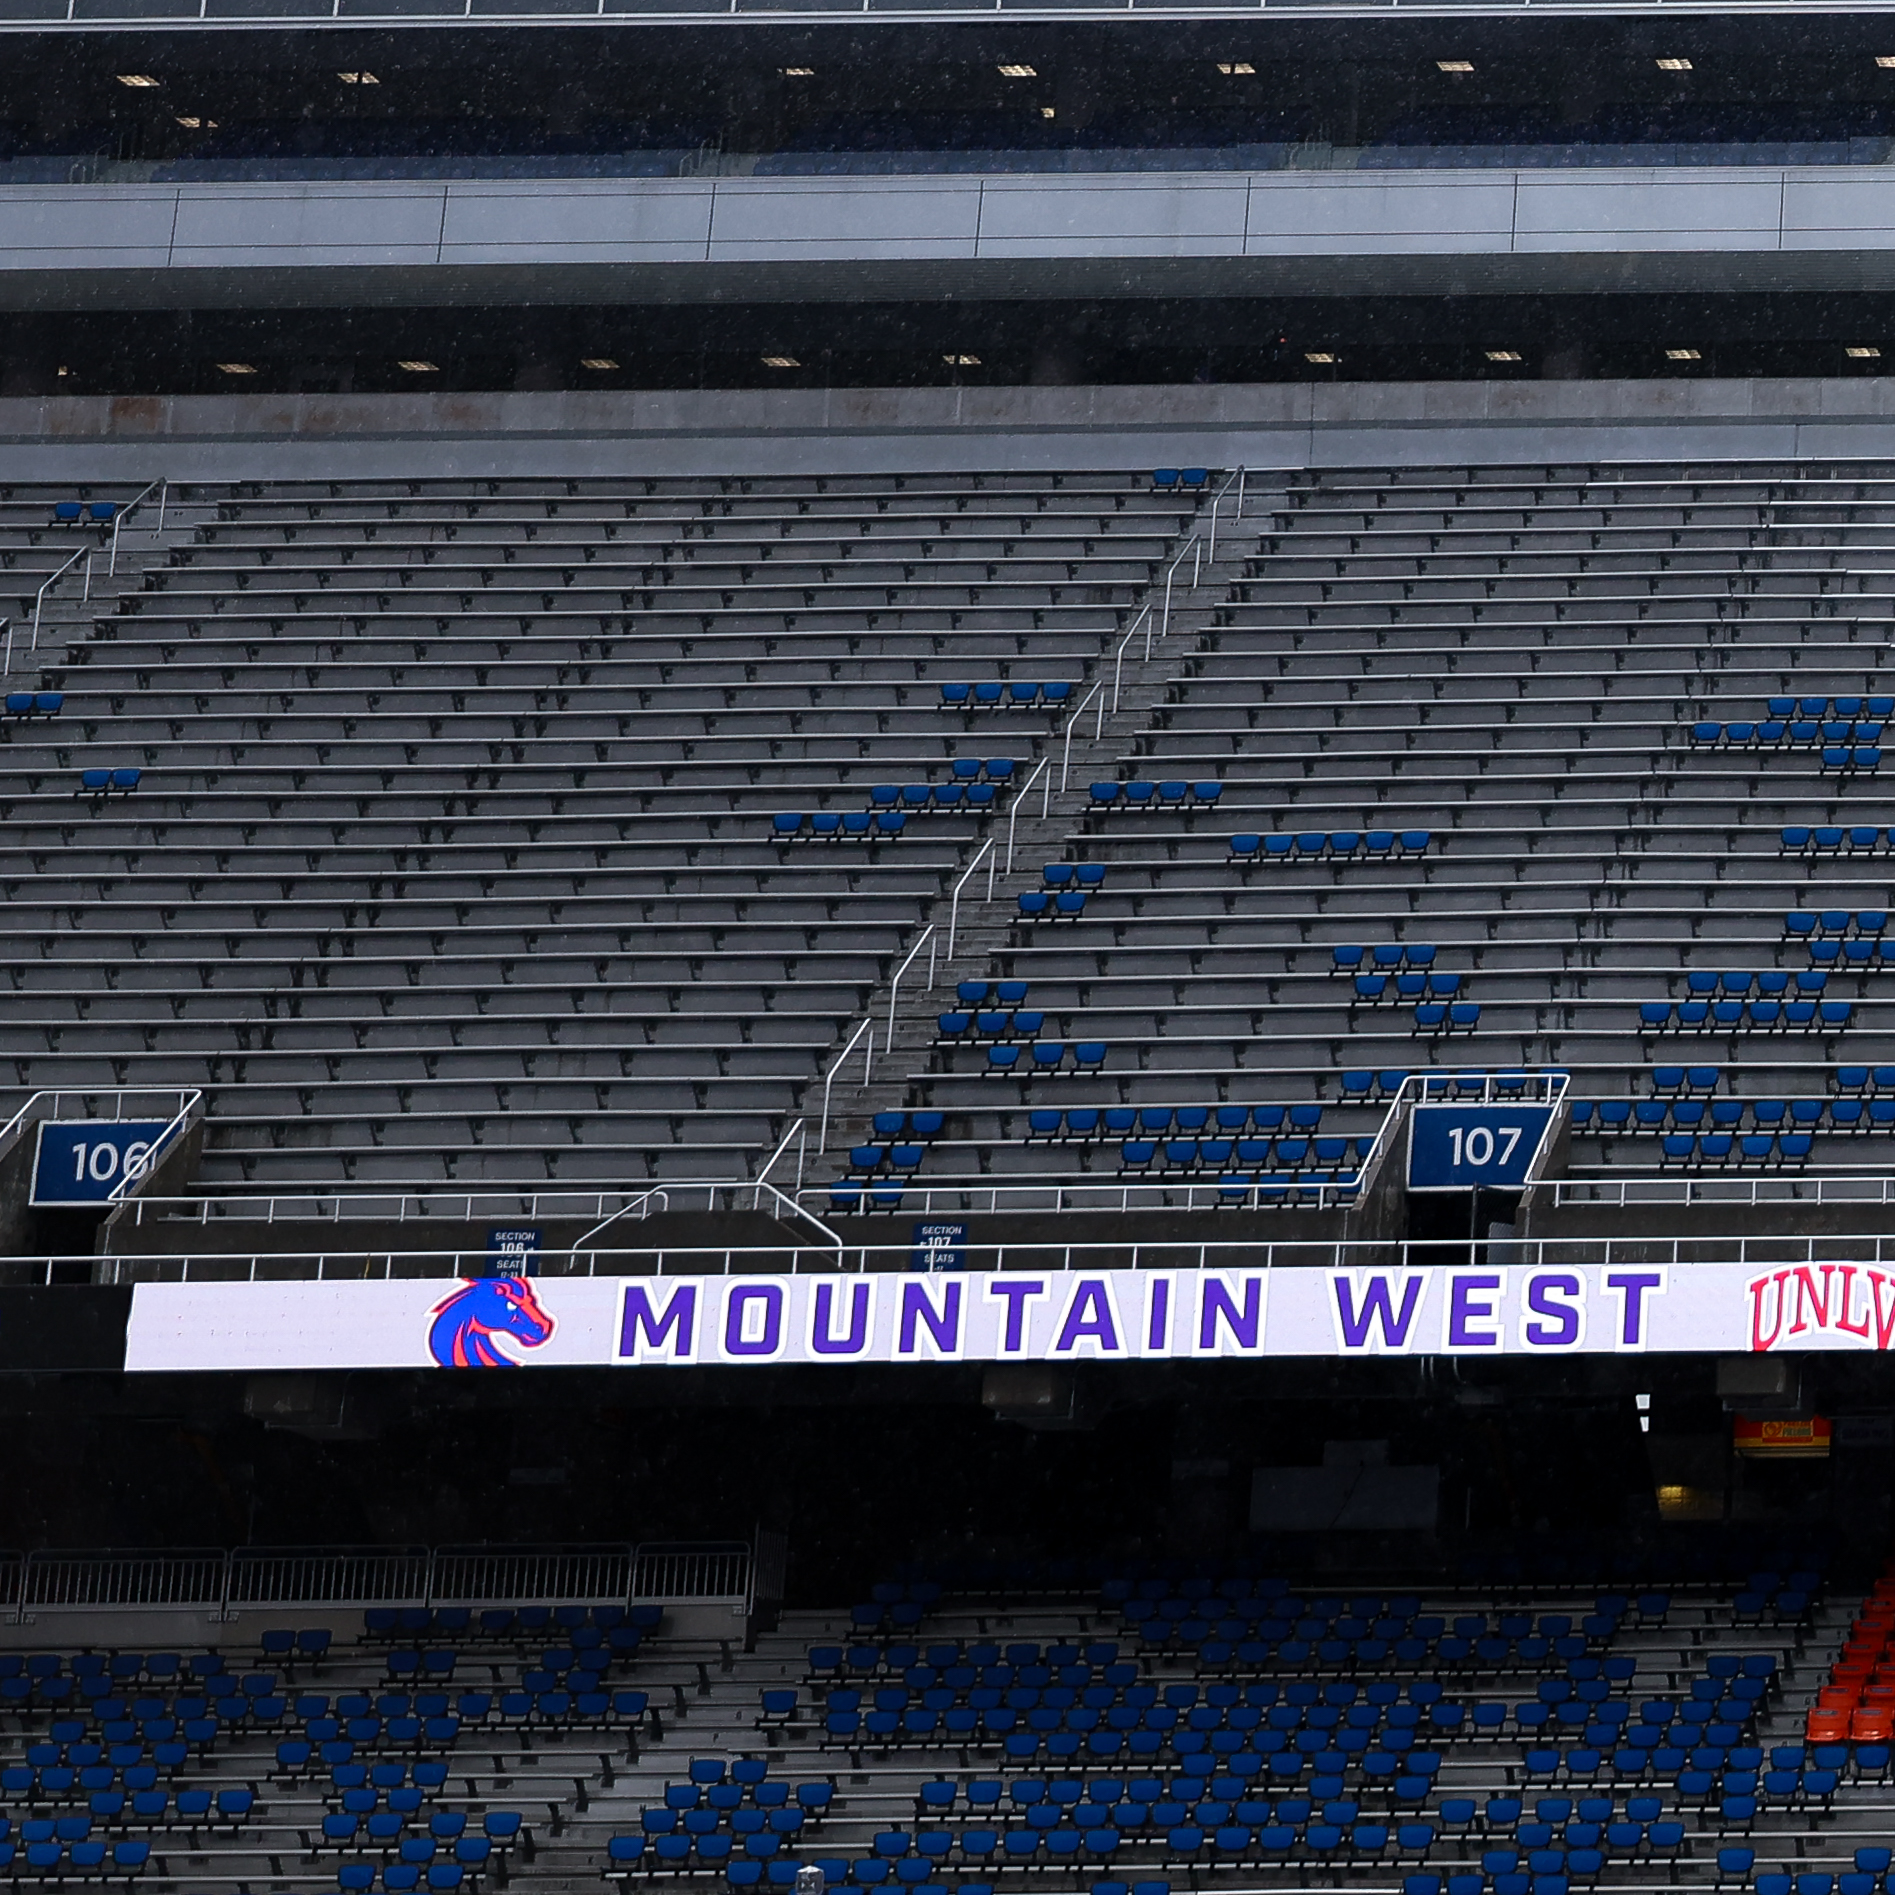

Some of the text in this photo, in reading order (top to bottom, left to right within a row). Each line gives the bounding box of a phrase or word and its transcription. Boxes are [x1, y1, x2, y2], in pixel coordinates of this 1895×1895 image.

[1448, 1127, 1522, 1166] 107
[72, 1141, 150, 1181] 106
[922, 1226, 962, 1235] SECTION
[495, 1232, 536, 1241] SECTION
[928, 1236, 951, 1248] 107
[924, 1254, 955, 1263] SATS
[496, 1260, 526, 1269] SEAT
[620, 1272, 1660, 1357] MOUNTAIN WEST
